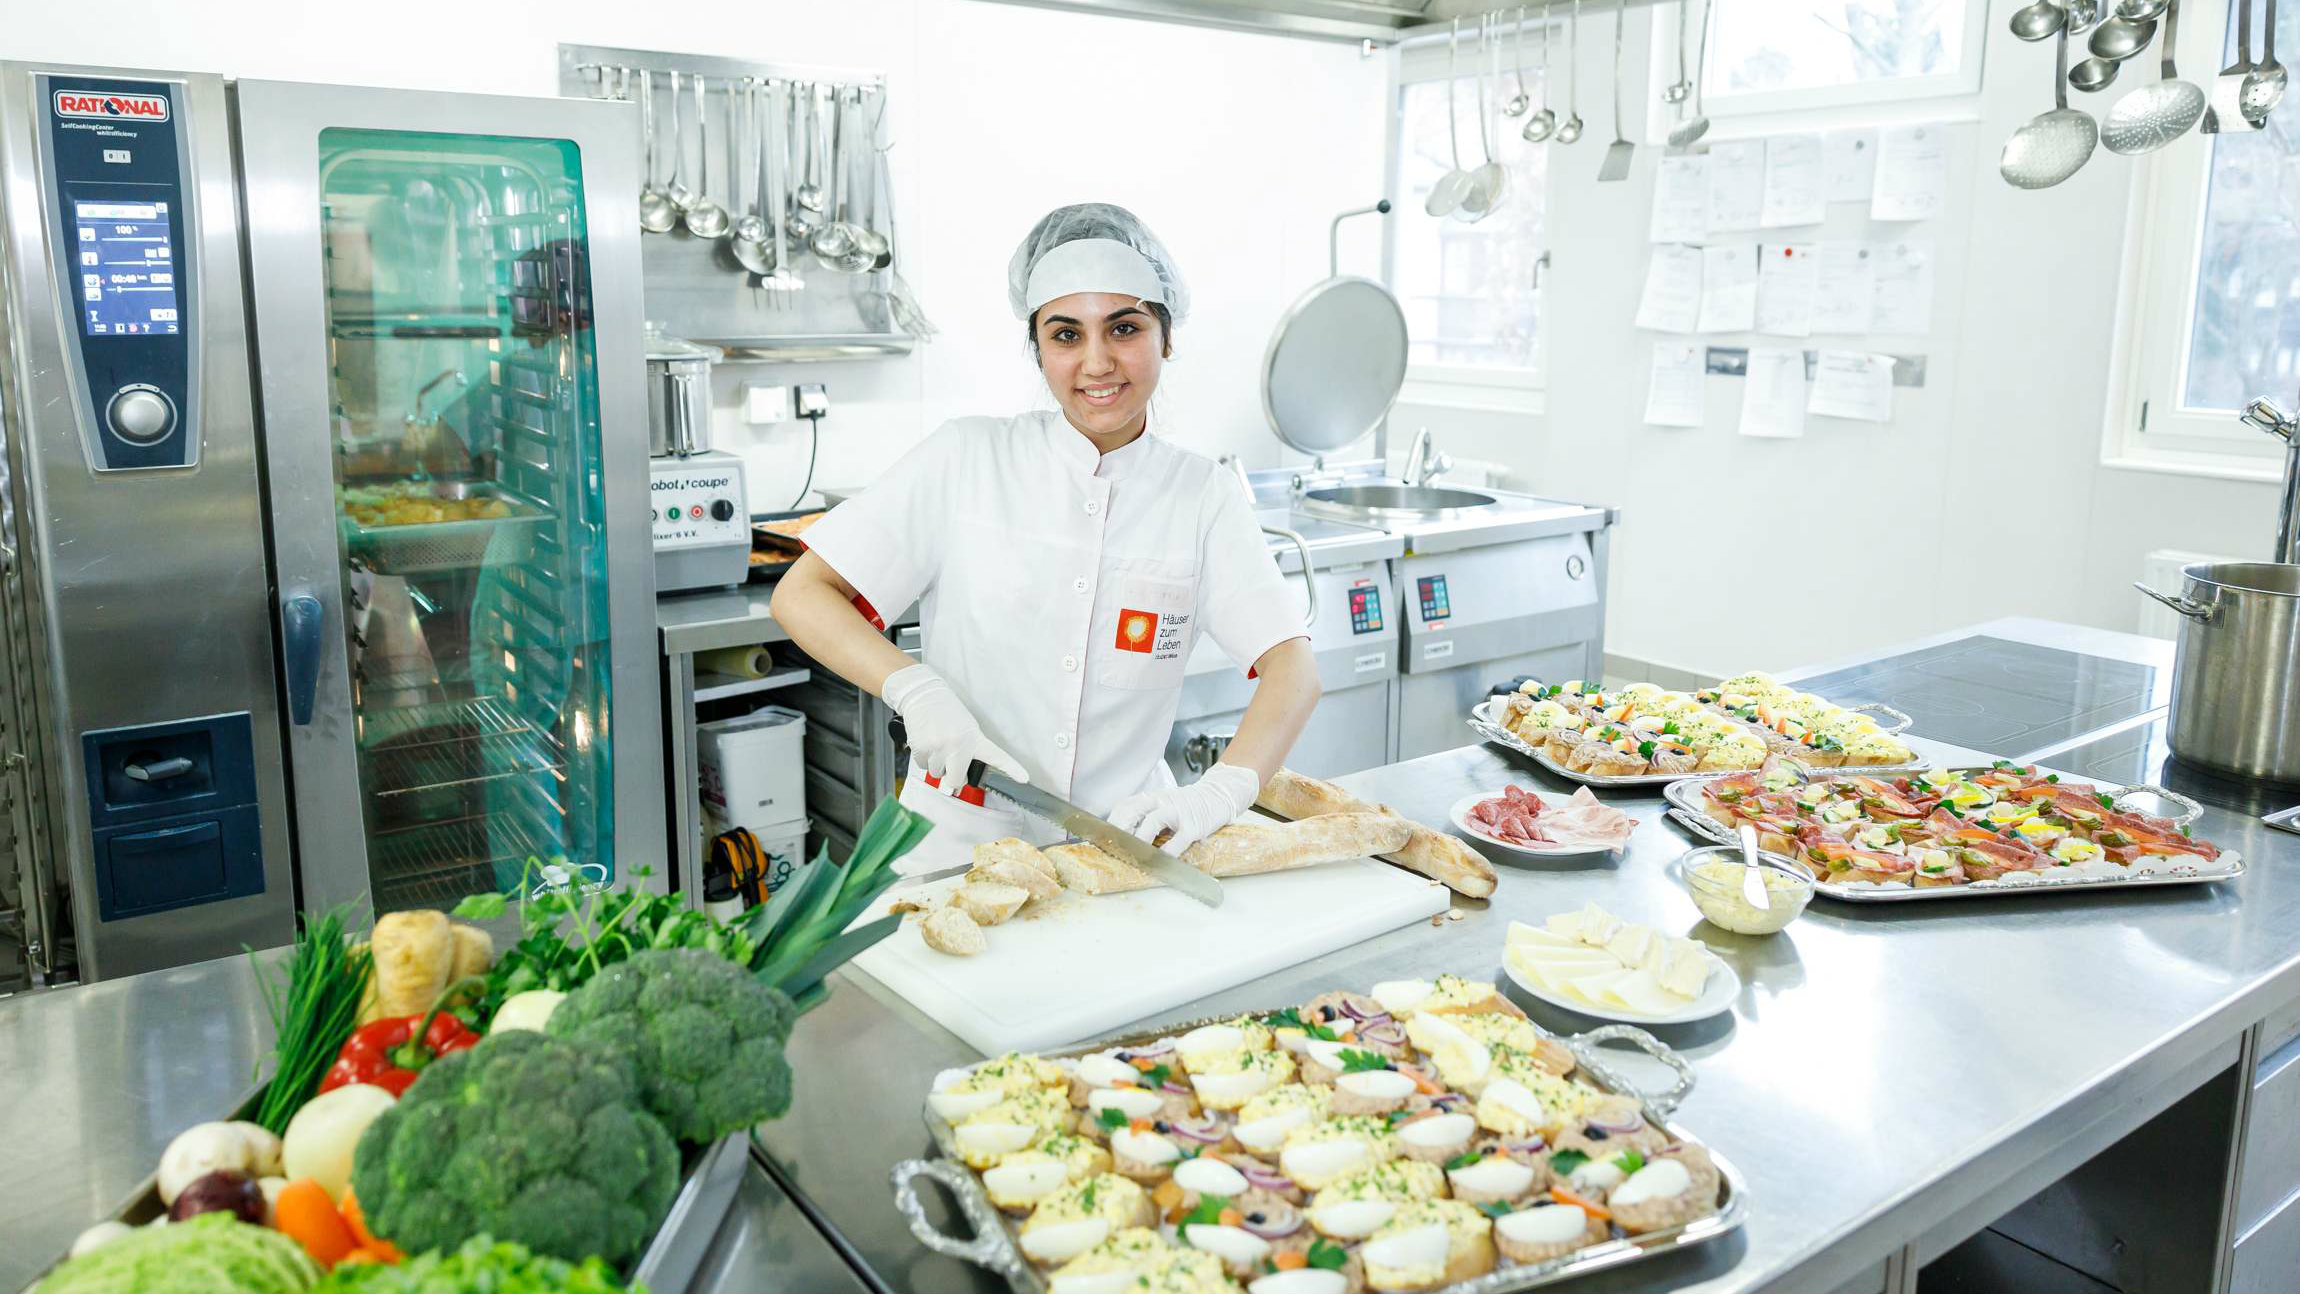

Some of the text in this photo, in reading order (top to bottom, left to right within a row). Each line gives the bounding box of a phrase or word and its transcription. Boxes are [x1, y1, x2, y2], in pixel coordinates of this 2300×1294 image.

[60, 96, 164, 116] RATIONAL
[651, 478, 728, 491] obot coupe
[1162, 613, 1190, 625] Häuser
[1160, 629, 1178, 638] zum
[1156, 639, 1181, 651] Leben
